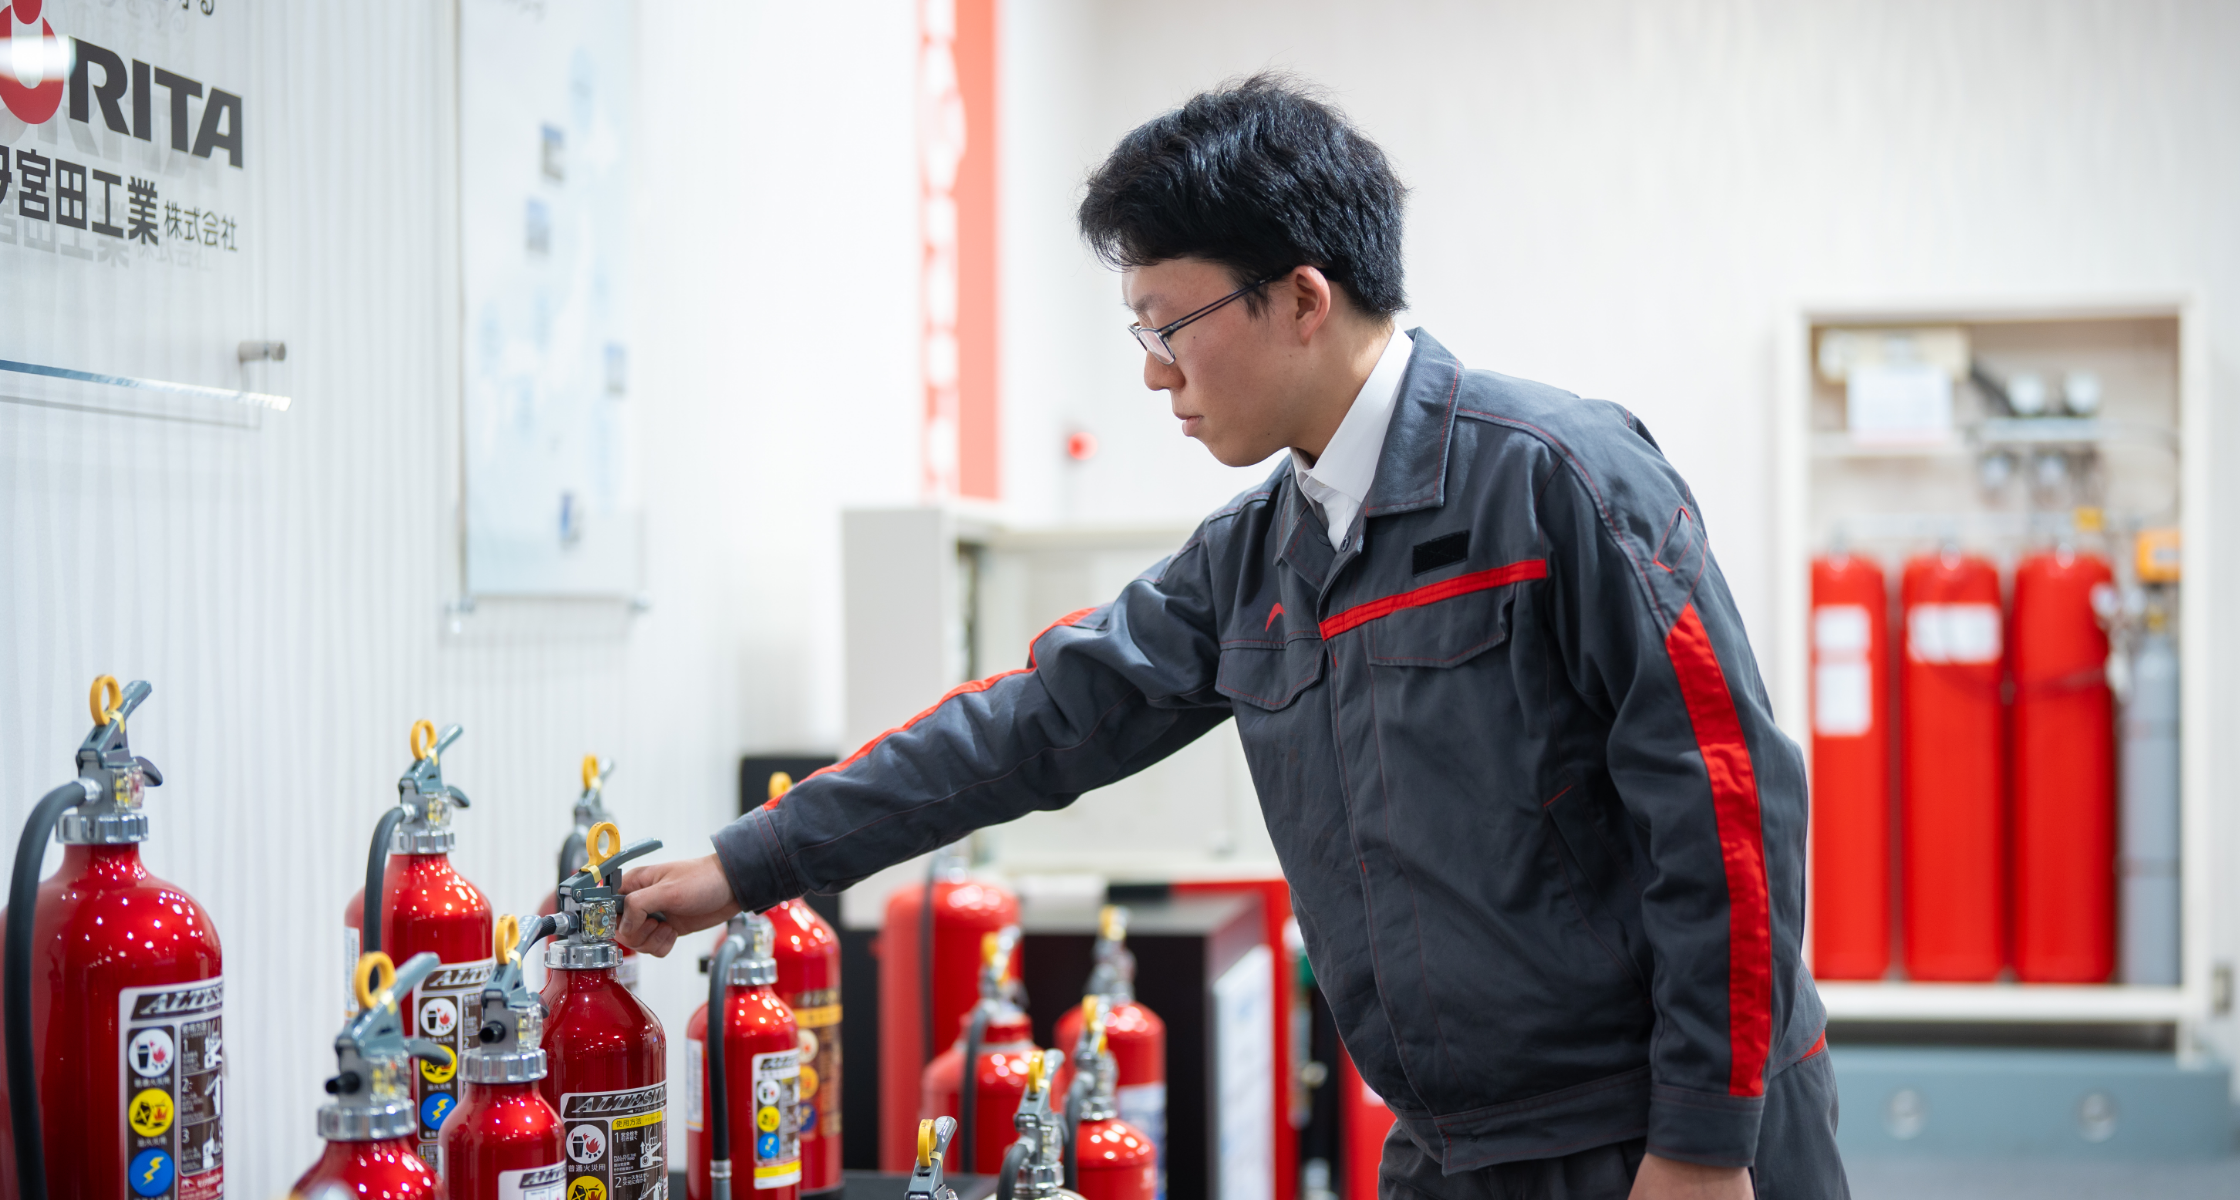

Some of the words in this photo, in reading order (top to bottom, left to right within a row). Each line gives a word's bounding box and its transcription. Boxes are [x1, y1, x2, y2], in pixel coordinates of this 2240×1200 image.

[615, 1117, 642, 1128] 使用方法
[614, 1132, 619, 1143] 1
[568, 1163, 606, 1173] 普通火災用
[615, 1177, 622, 1188] 2
